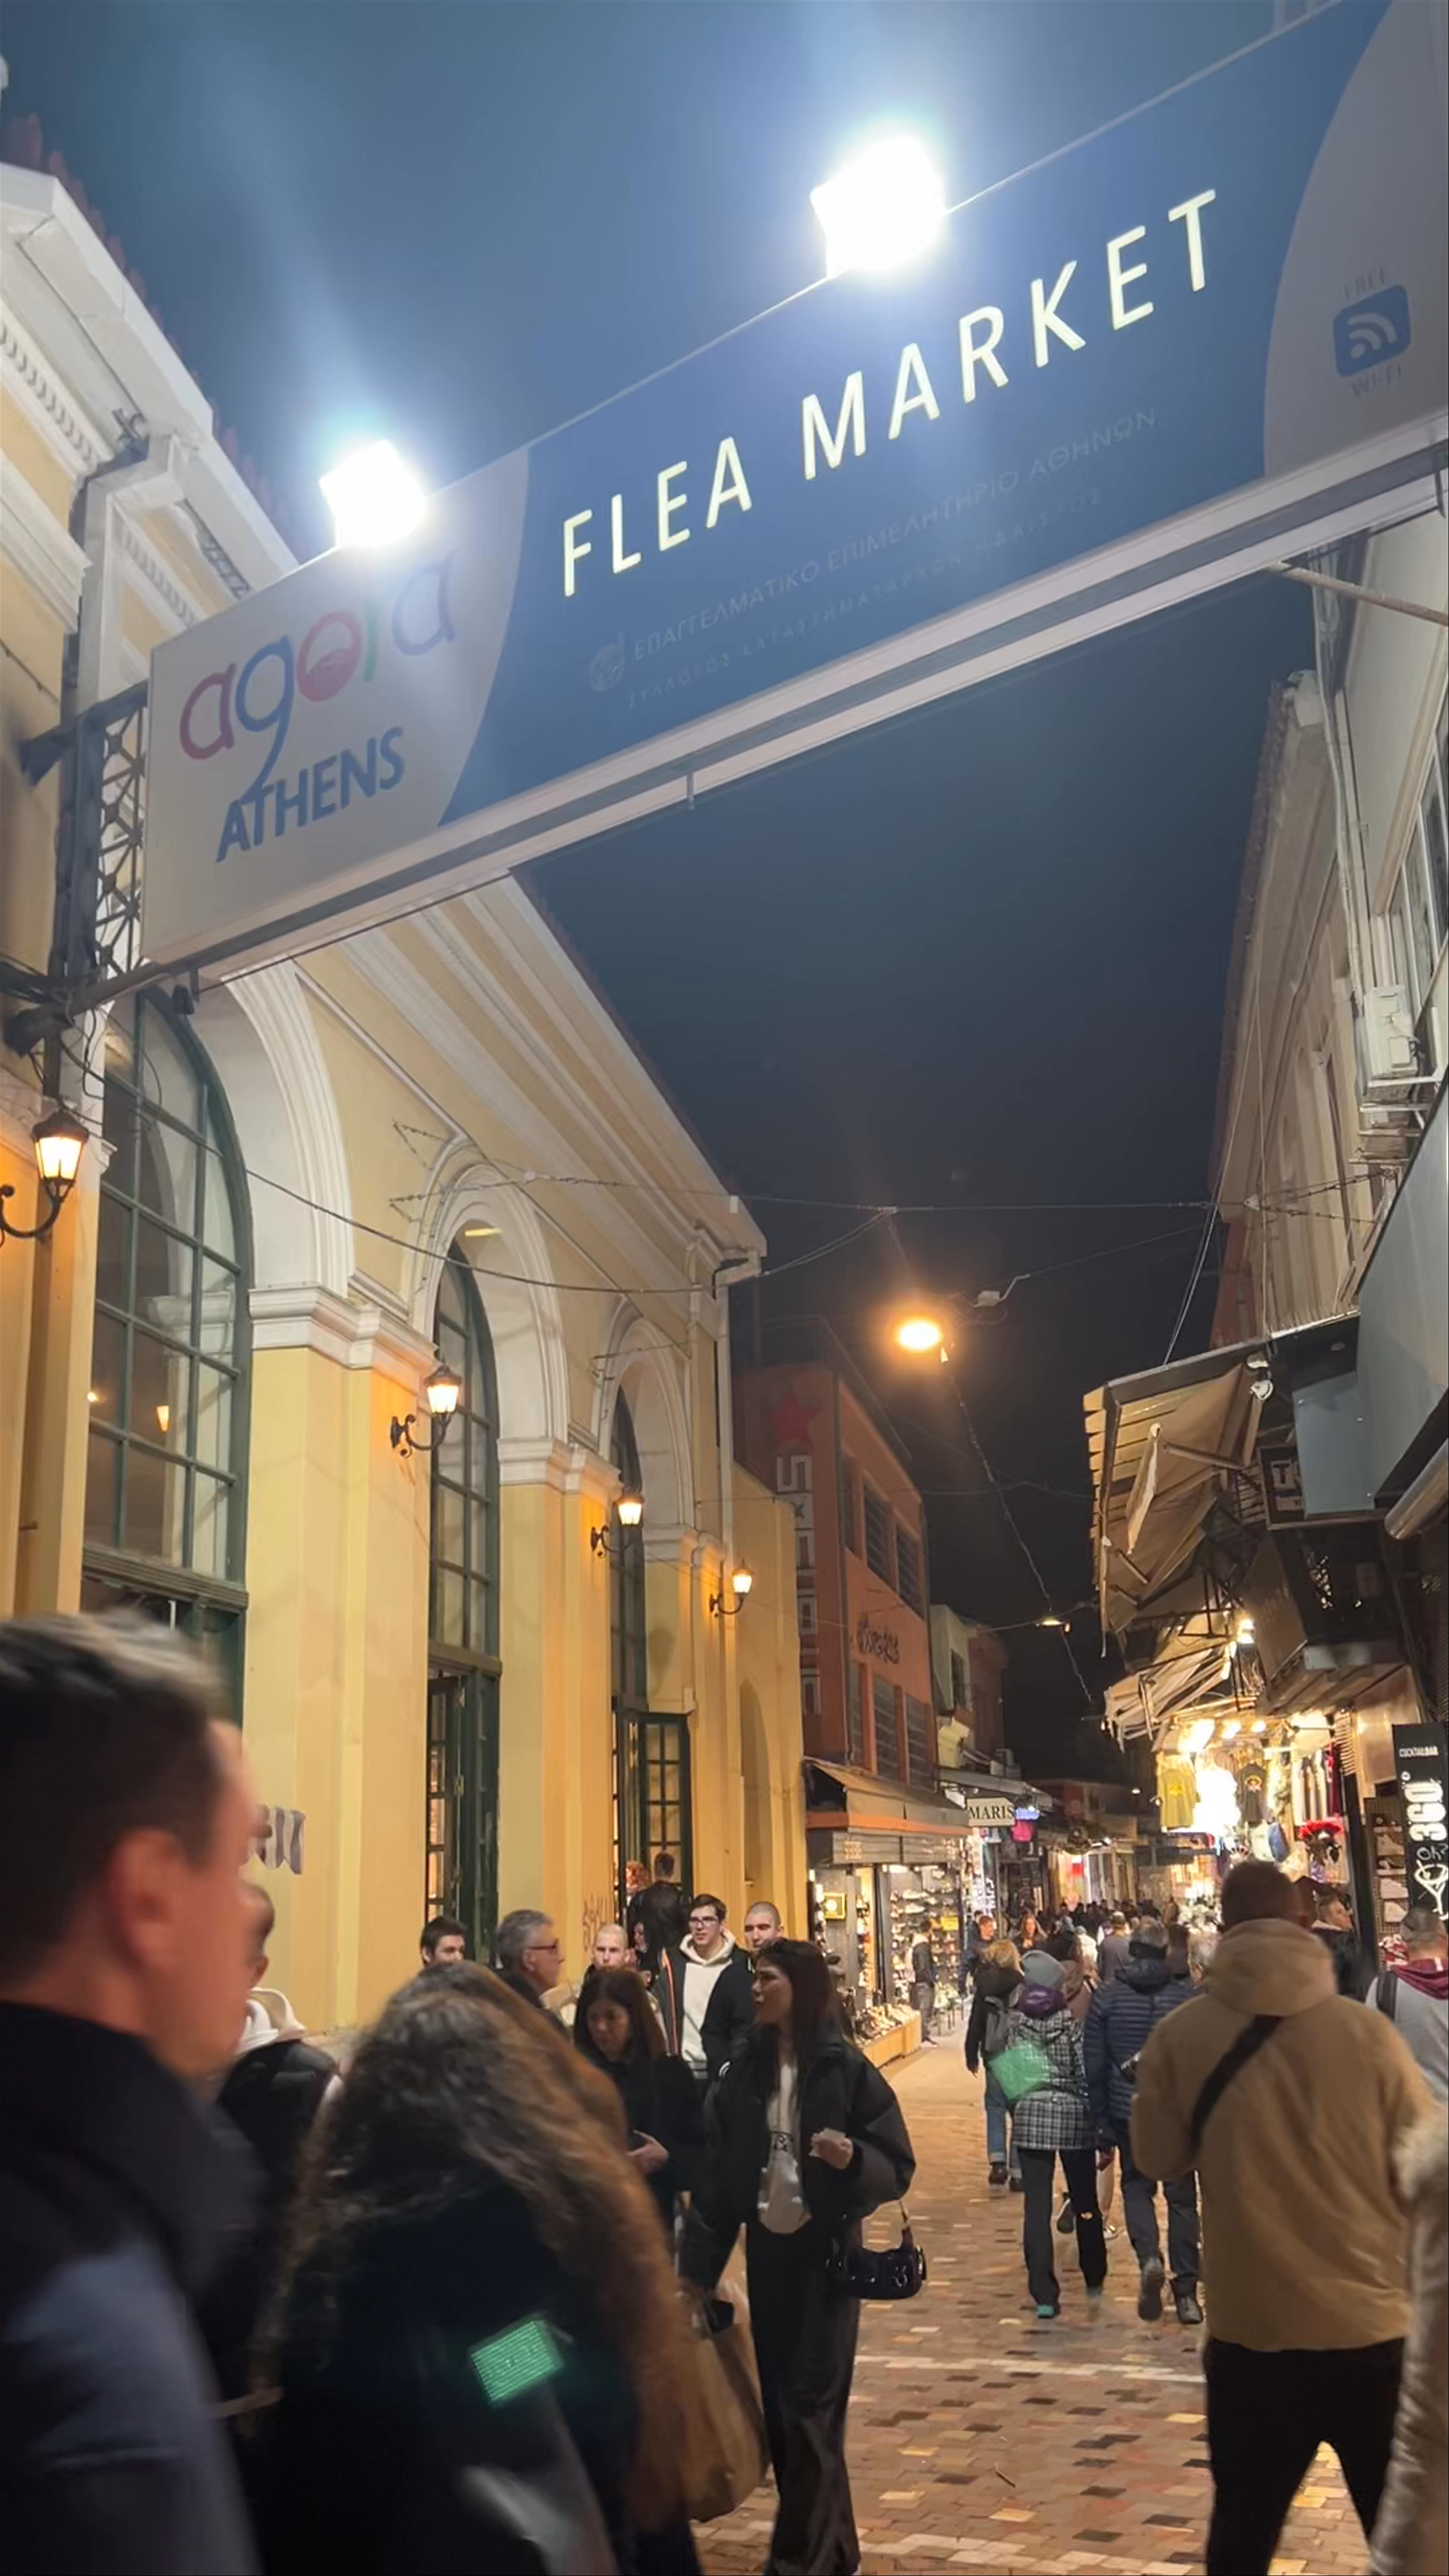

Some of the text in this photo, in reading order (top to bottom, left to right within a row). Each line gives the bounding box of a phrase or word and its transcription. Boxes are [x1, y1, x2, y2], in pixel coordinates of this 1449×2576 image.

[564, 189, 1215, 596] FLEA MARKET
[634, 406, 1157, 661] ΕΠΑΓΓΕΛΜΑΤΙΚΟ ΕΠΙΜΕΛΗΤΗΡΙΟ ΑΘΗΝΩΝ
[216, 725, 405, 863] ATHENS
[969, 1804, 1015, 1820] MARIS
